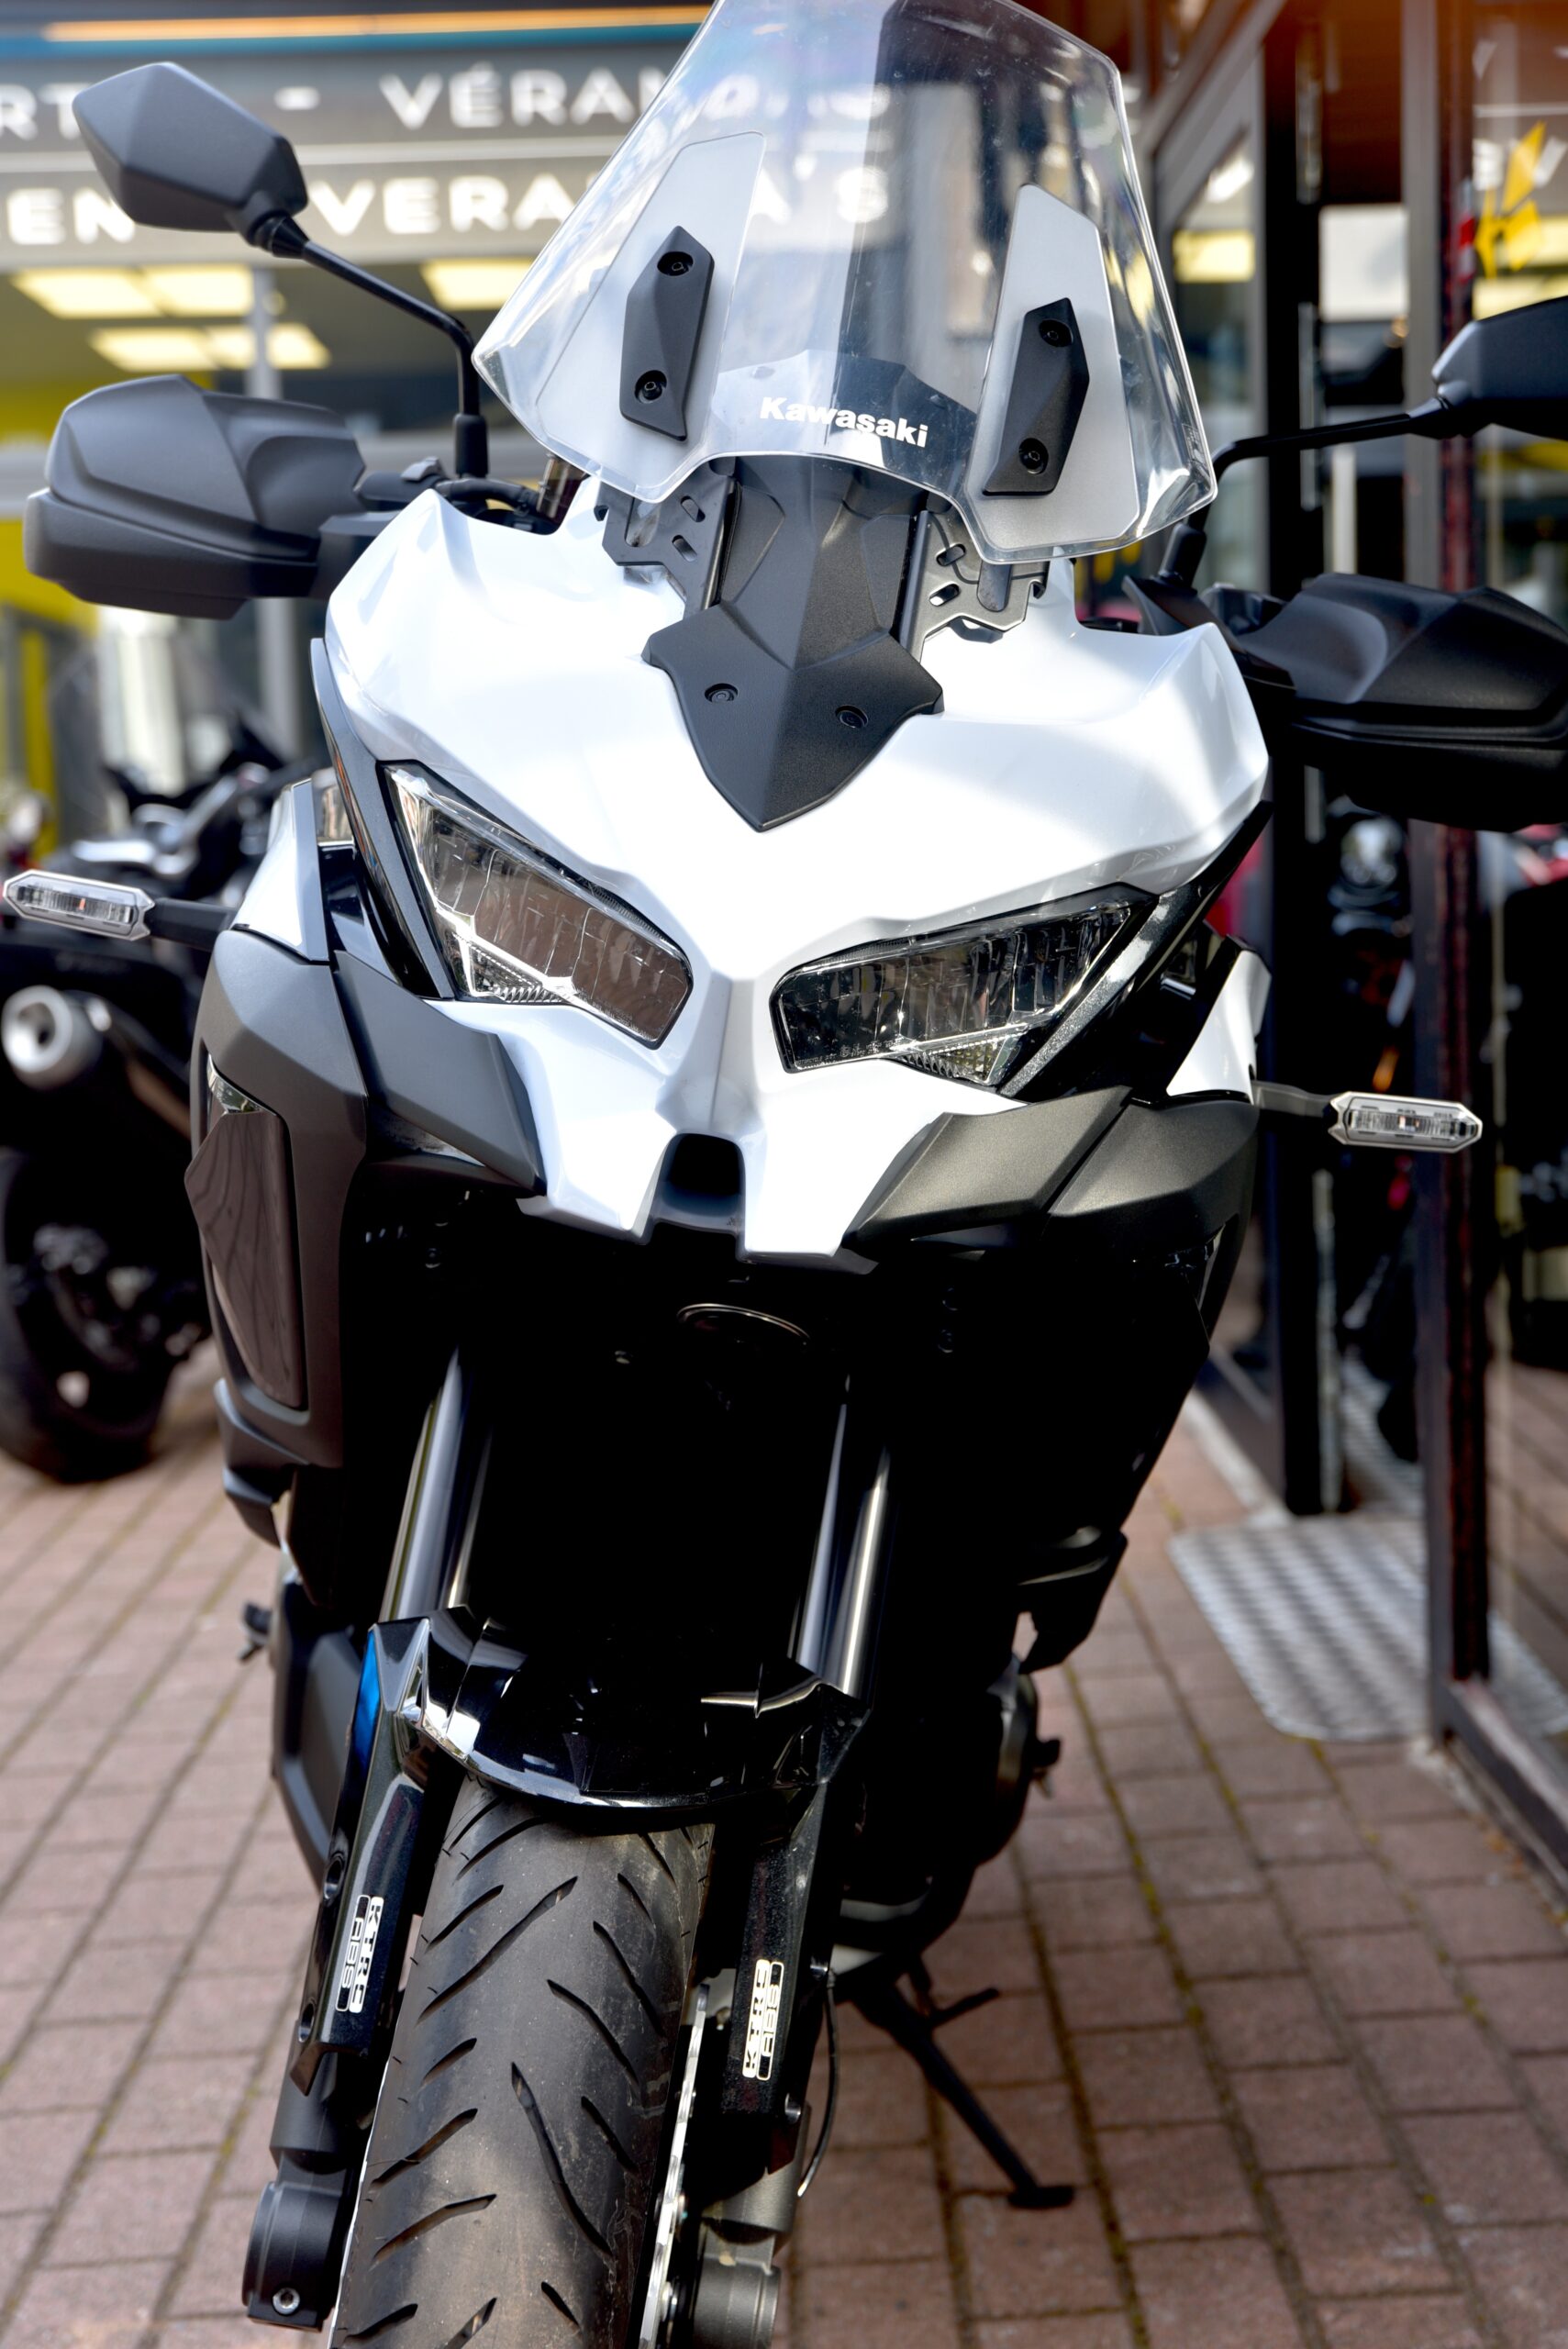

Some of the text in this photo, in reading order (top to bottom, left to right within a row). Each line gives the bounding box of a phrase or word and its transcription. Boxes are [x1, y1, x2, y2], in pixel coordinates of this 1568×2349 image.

[760, 397, 928, 448] Kawasaki
[341, 1917, 365, 1988] ABS
[351, 1904, 381, 2005] KTRC
[745, 1969, 768, 2069] KTRC
[761, 1984, 780, 2057] ABS
